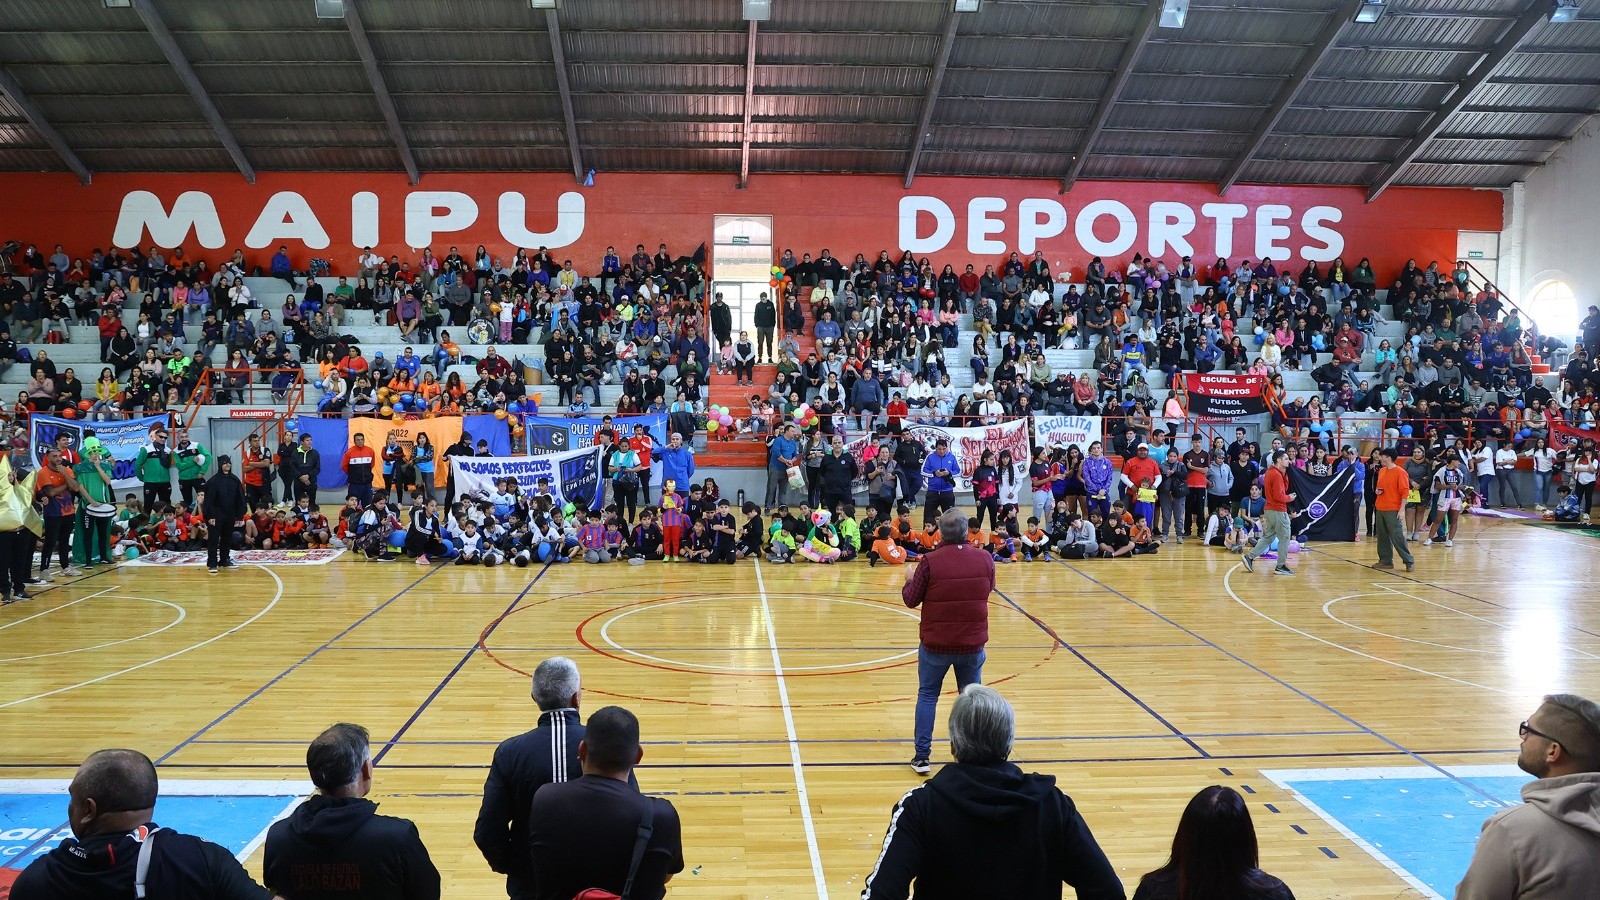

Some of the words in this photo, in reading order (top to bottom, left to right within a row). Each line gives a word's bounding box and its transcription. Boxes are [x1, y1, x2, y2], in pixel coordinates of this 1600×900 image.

[113, 190, 586, 253] MAIPU
[898, 195, 1345, 262] DEPORTES
[1200, 376, 1237, 384] ESCUELA
[571, 423, 589, 435] QUE
[1038, 416, 1092, 435] ESCUELITA
[986, 428, 1005, 440] EL
[459, 461, 470, 472] NO
[470, 462, 501, 475] SOMOS
[502, 459, 552, 475] PERFECTOS
[322, 874, 361, 890] BAZAN
